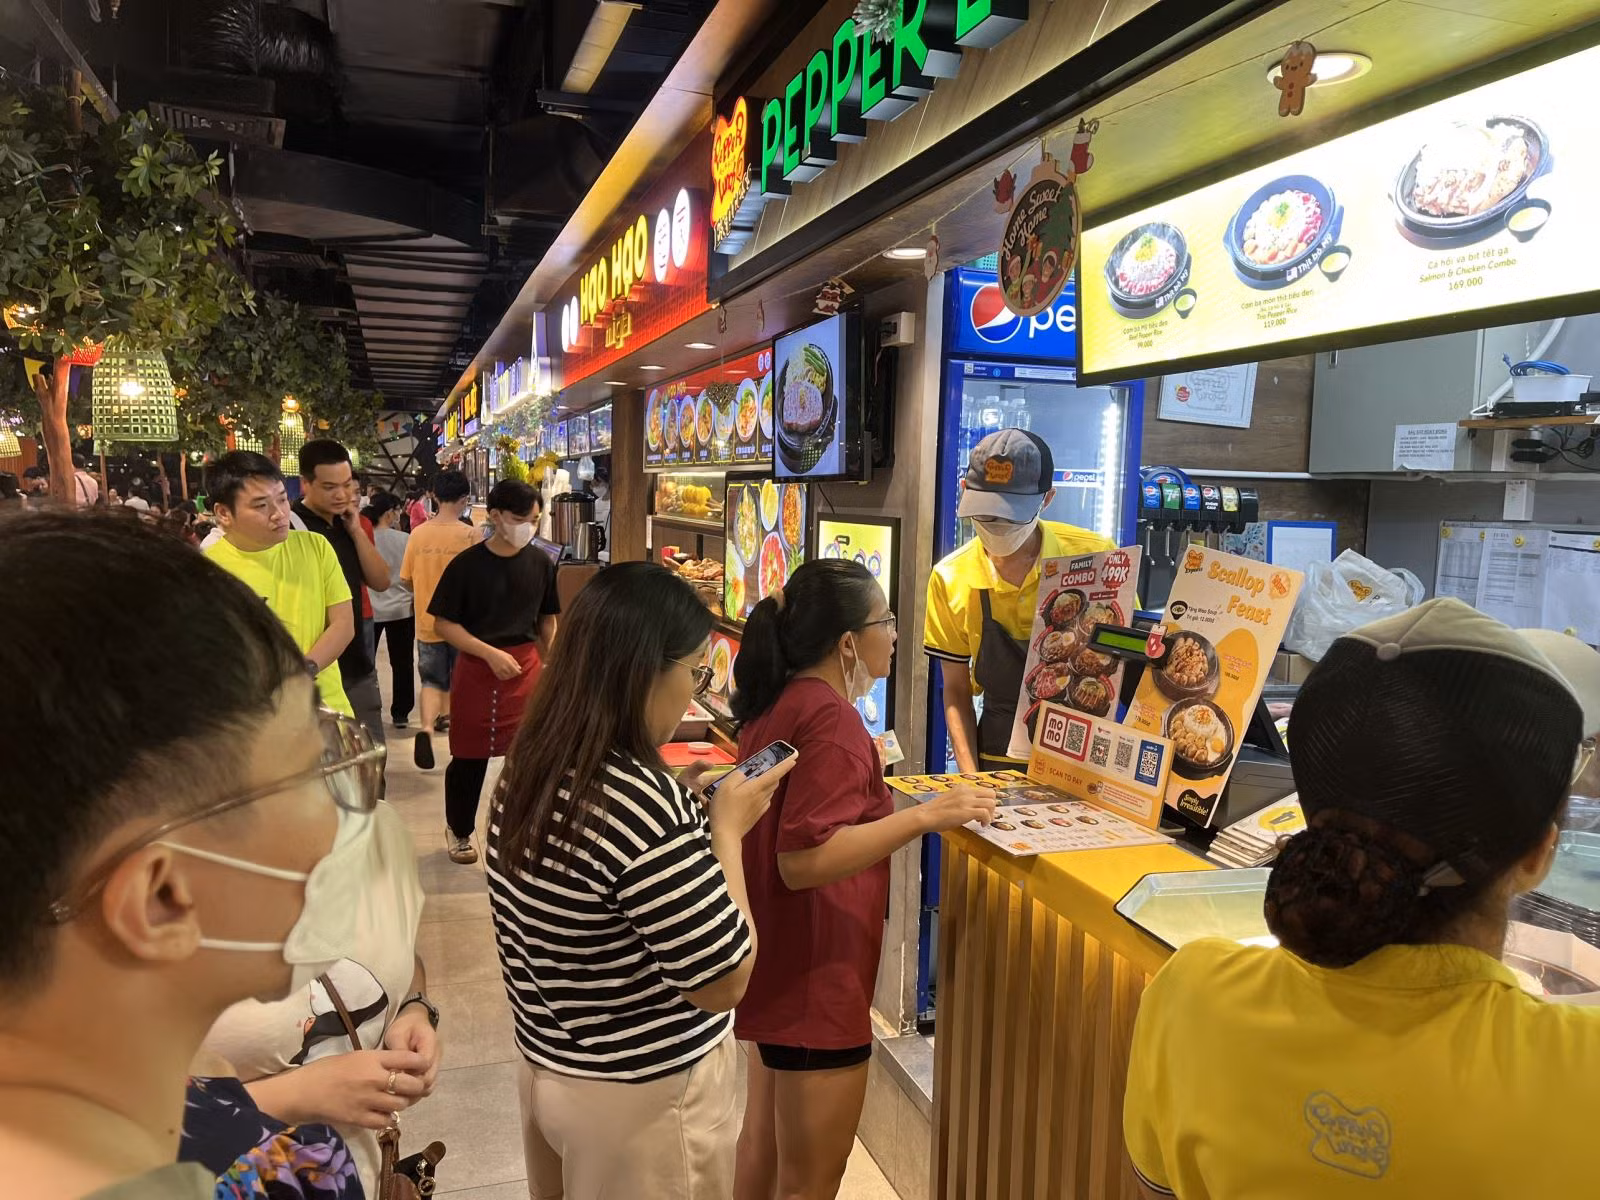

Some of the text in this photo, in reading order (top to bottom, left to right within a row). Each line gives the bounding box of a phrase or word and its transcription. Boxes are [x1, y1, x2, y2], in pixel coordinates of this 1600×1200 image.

[761, 0, 927, 195] PEPPER
[1002, 185, 1062, 260] Home Sweet
[1018, 207, 1048, 247] Home
[1419, 258, 1517, 283] Salmon & Chicken Combo
[1448, 276, 1484, 291] 169.000
[1074, 473, 1096, 483] pepsi
[1071, 560, 1093, 570] FAMILY
[1108, 554, 1127, 565] ONLY
[1062, 571, 1095, 586] COMBO
[1101, 565, 1129, 582] 499K
[1208, 561, 1265, 598] Scallop
[1227, 594, 1272, 625] Feast
[1048, 767, 1064, 778] SCAN
[1064, 772, 1072, 780] TO
[1072, 775, 1083, 786] PAY
